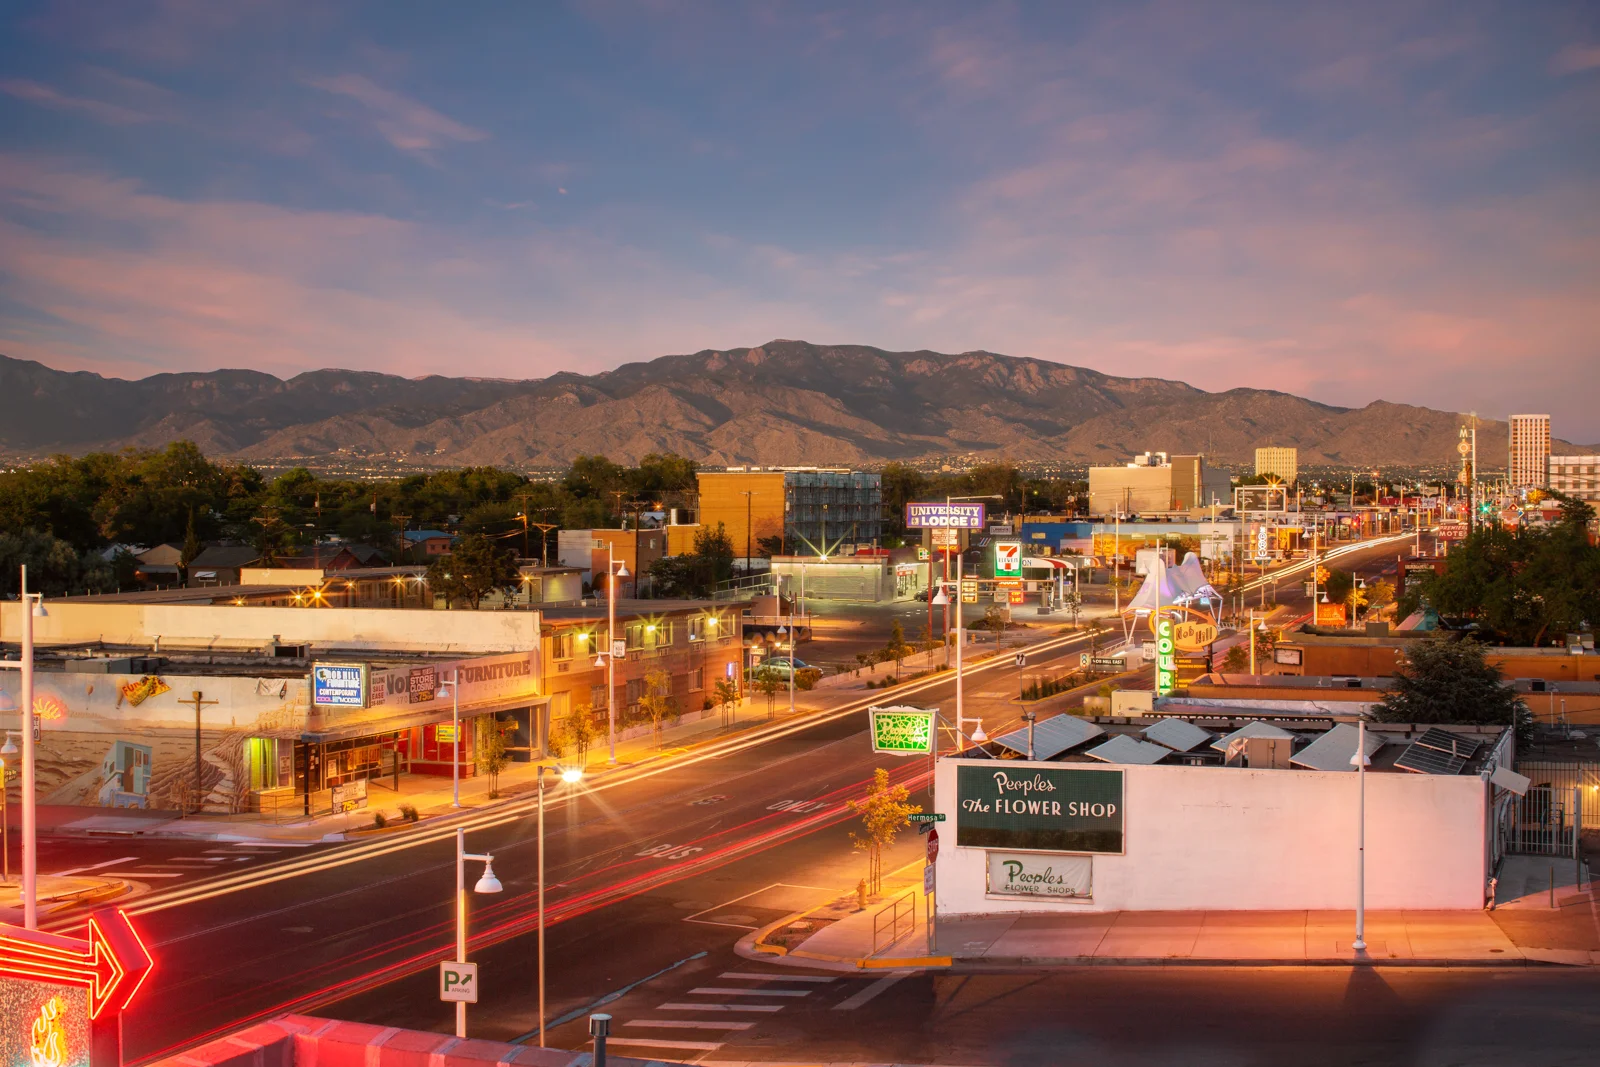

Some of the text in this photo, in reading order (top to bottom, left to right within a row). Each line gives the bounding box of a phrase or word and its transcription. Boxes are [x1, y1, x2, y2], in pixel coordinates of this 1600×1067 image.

[910, 506, 980, 516] UNIVERSITY
[921, 516, 969, 527] LODGE
[998, 545, 1018, 558] 7
[1175, 626, 1213, 645] Nob Hill
[410, 674, 434, 685] STORE
[455, 659, 531, 685] FURNITURE
[410, 682, 434, 693] CLOSING
[993, 771, 1056, 796] Peoples
[962, 799, 1117, 818] The FLOWER SHOP
[634, 843, 704, 860] BUS
[1003, 860, 1067, 884] Peoples
[1005, 884, 1076, 895] FLOWER SHOPS
[444, 970, 460, 992] P
